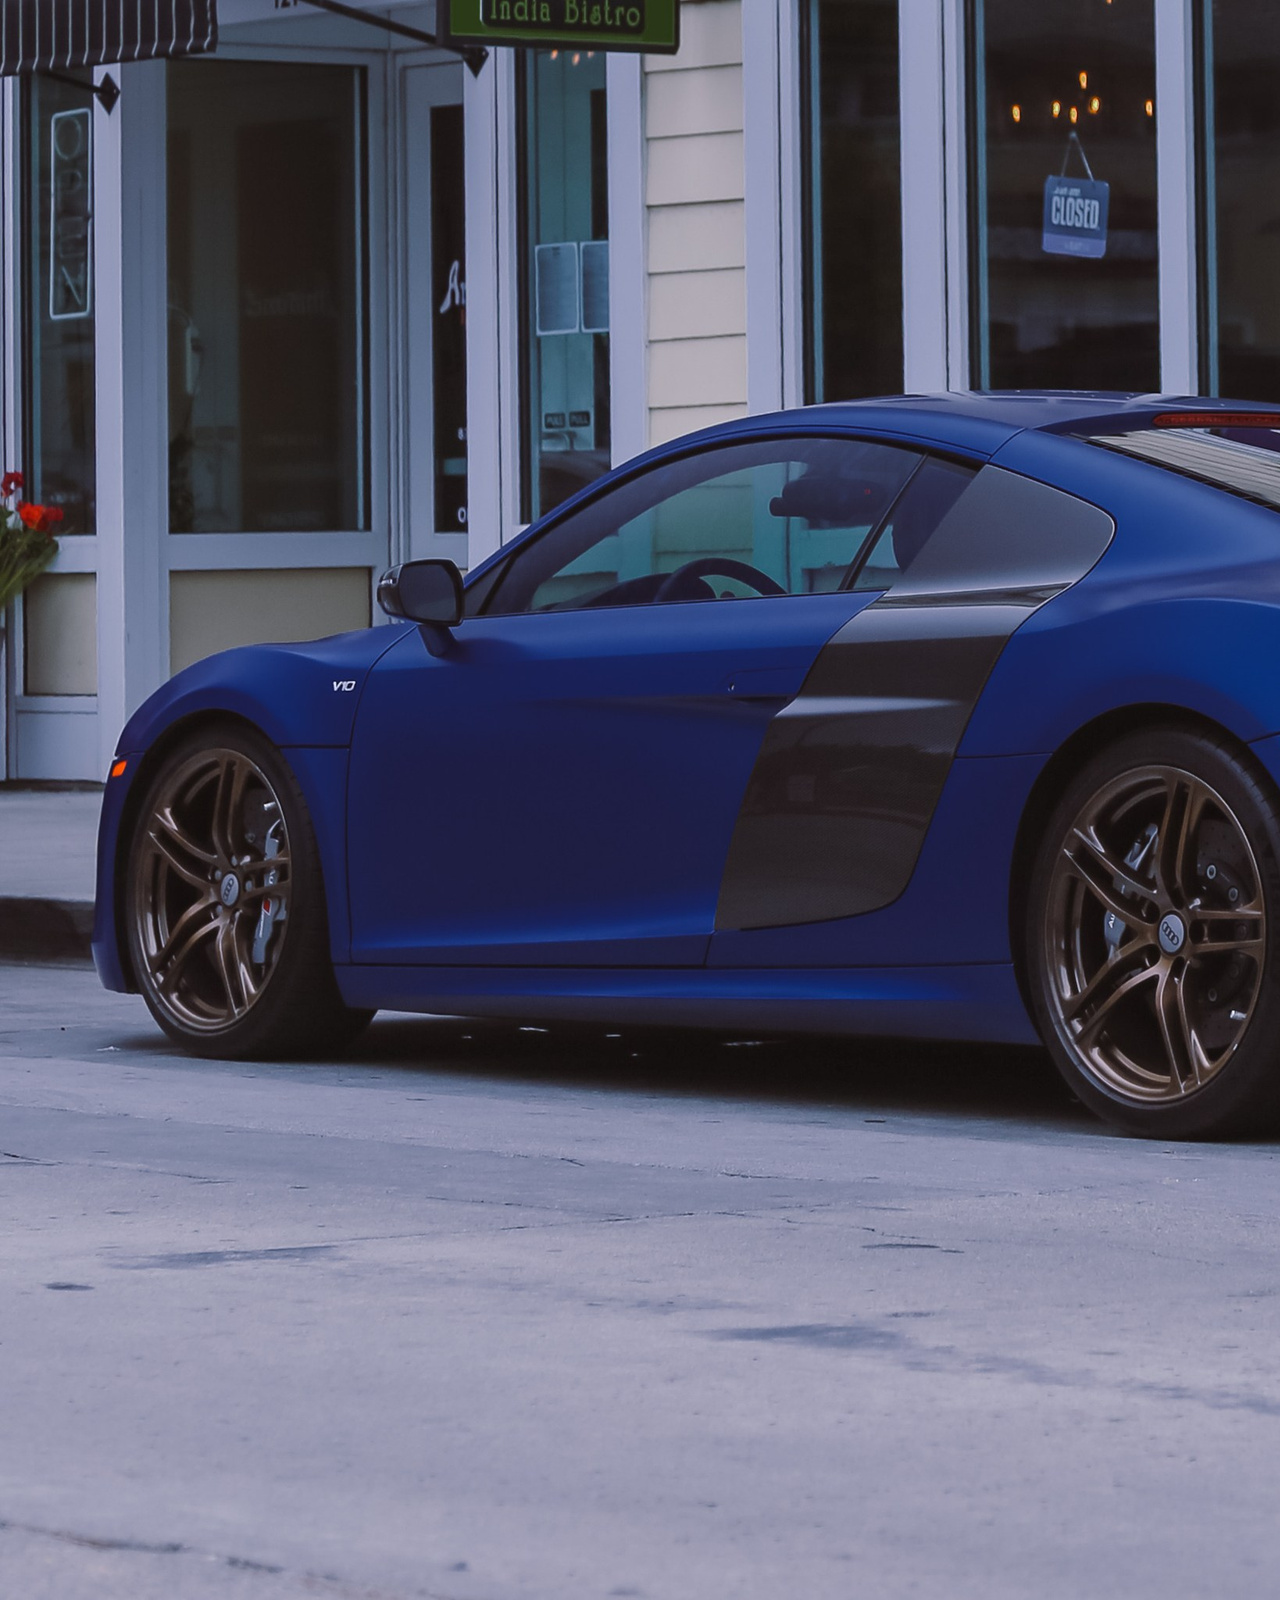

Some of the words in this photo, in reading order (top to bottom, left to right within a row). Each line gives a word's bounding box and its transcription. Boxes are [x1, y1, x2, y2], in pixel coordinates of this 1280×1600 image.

[55, 115, 86, 306] OPEN
[1051, 196, 1100, 230] CLOSED
[333, 681, 356, 691] V10
